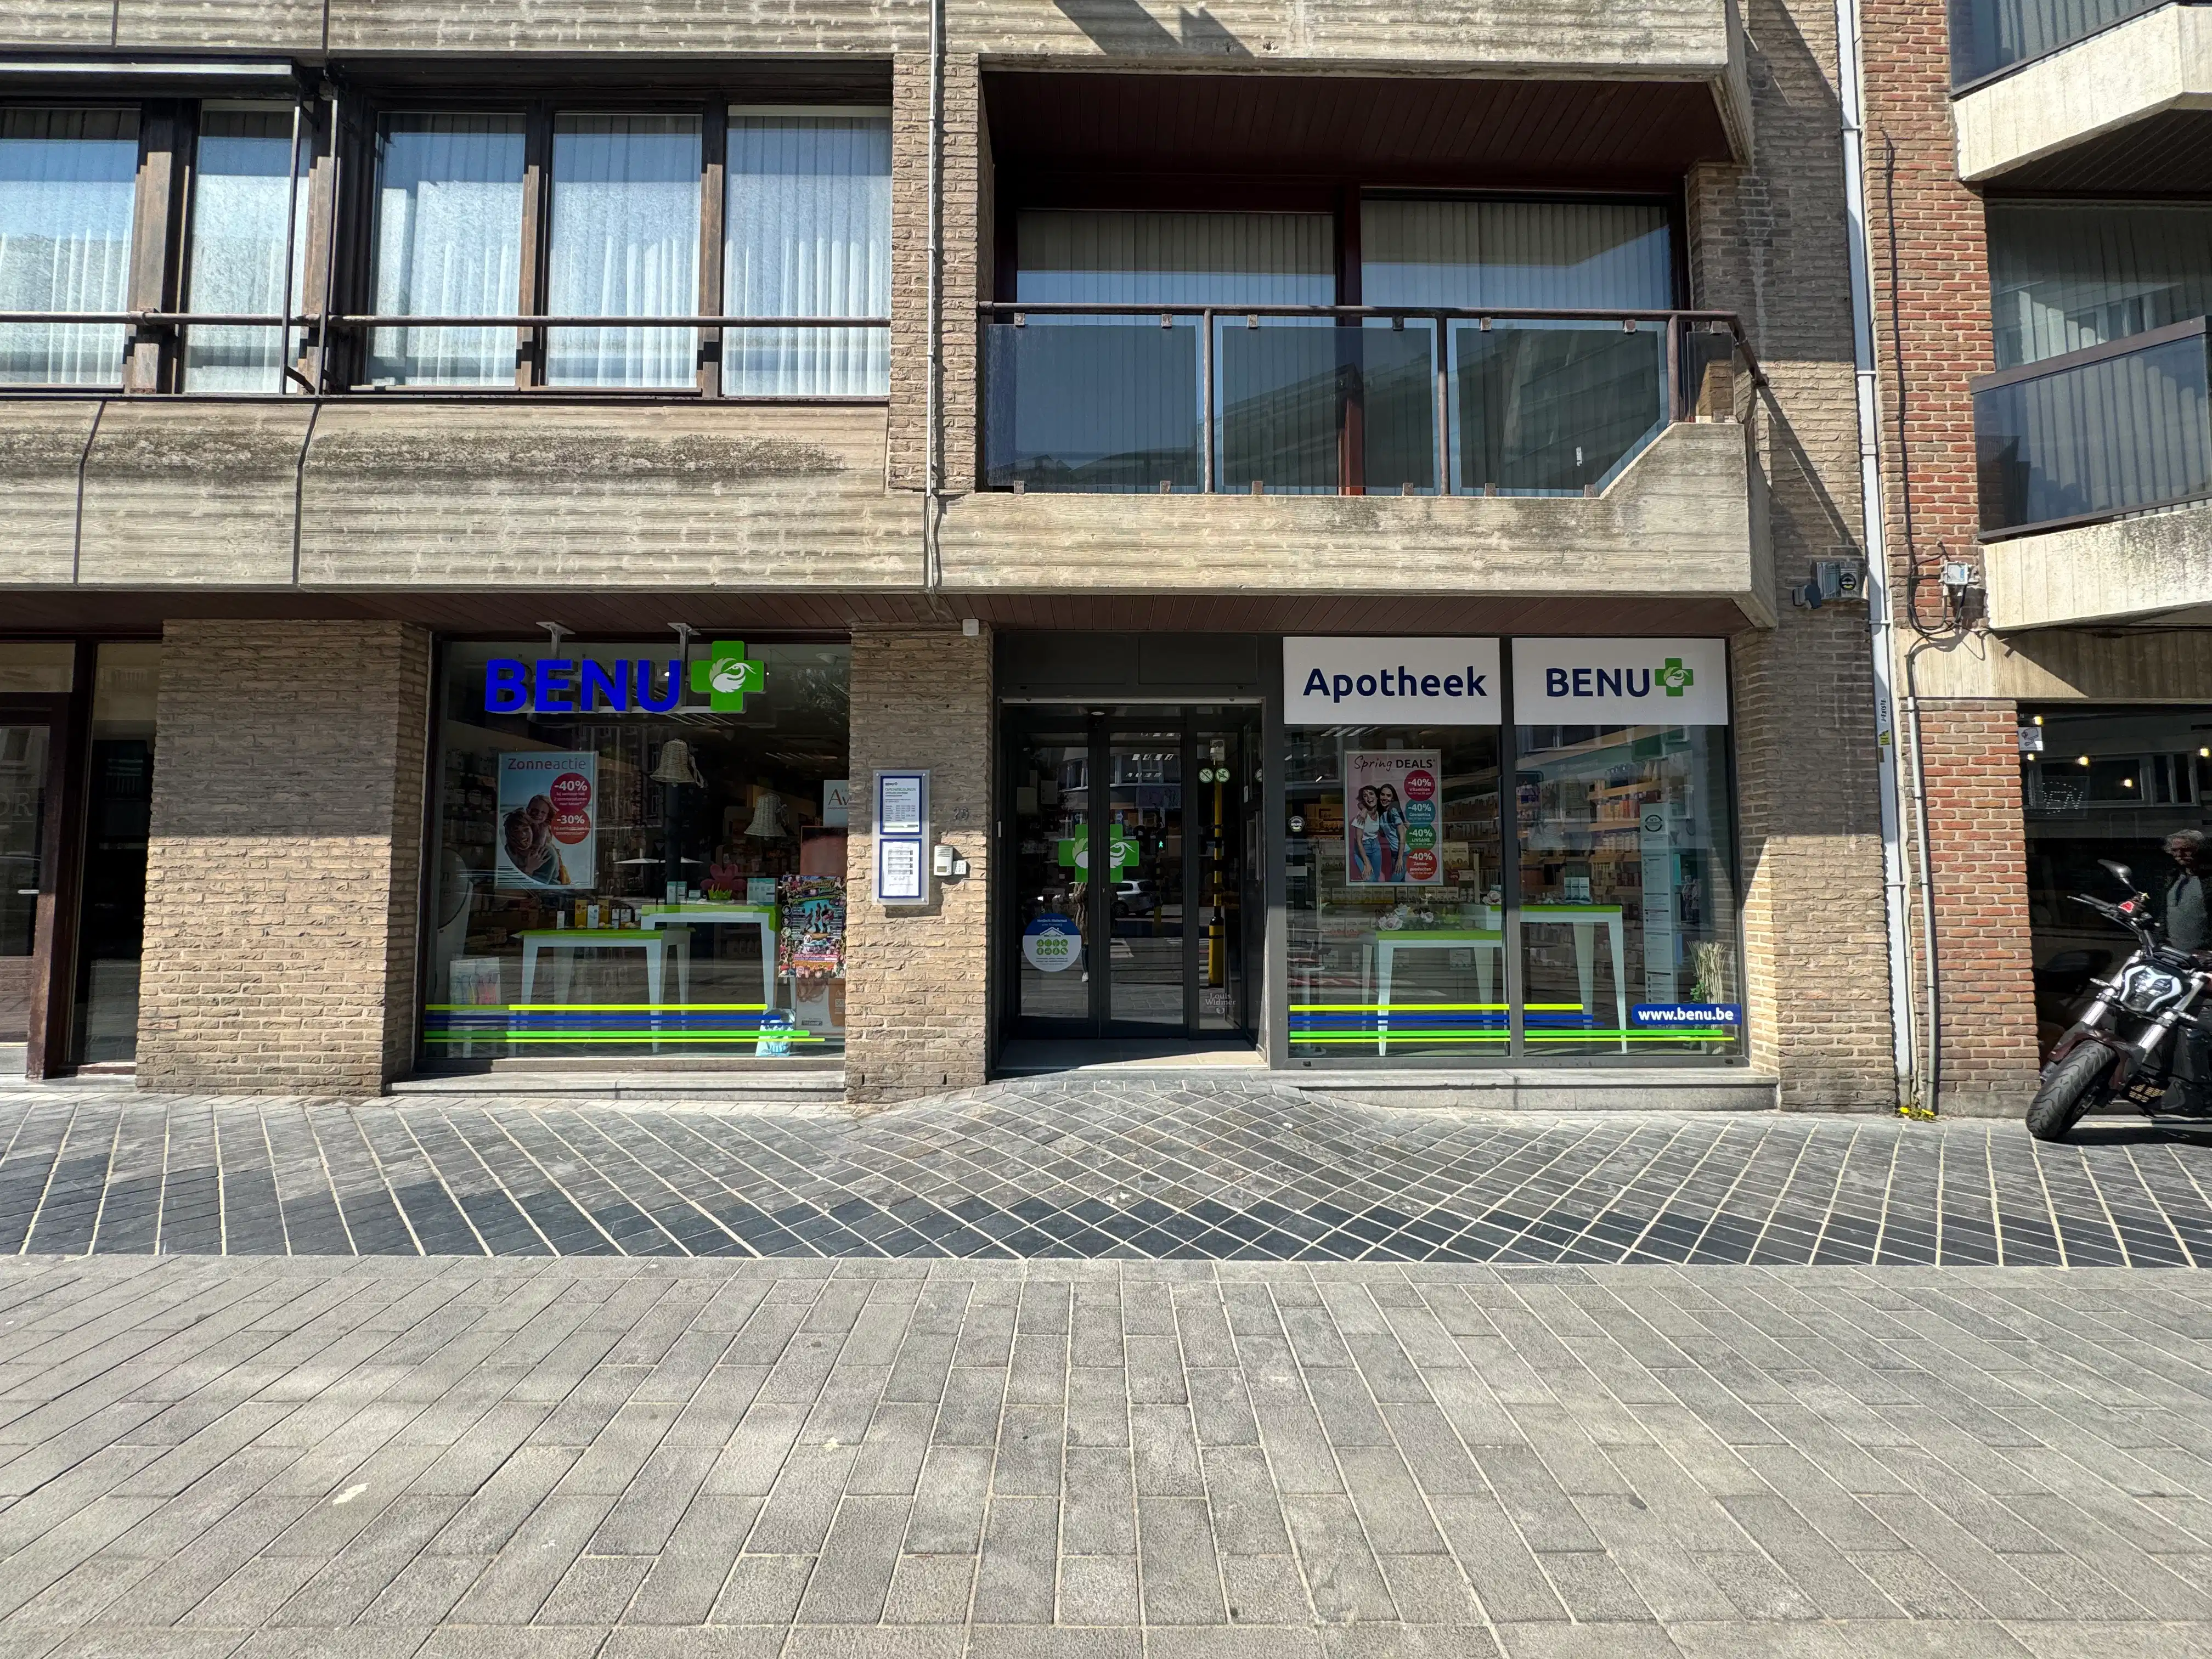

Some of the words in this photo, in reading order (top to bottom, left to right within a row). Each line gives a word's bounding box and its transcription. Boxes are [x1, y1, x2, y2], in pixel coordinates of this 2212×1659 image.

[484, 659, 682, 713] BENU
[1303, 665, 1488, 703] Apotheek
[1546, 668, 1650, 697] BENU
[507, 758, 586, 770] Zonneactie
[1354, 755, 1392, 772] Spring
[554, 780, 588, 791] -40%
[1408, 778, 1431, 787] -40%
[1408, 803, 1432, 811] -40%
[556, 815, 585, 824] -30%
[1409, 829, 1432, 837] -40%
[1638, 1007, 1734, 1020] www.benu.be
